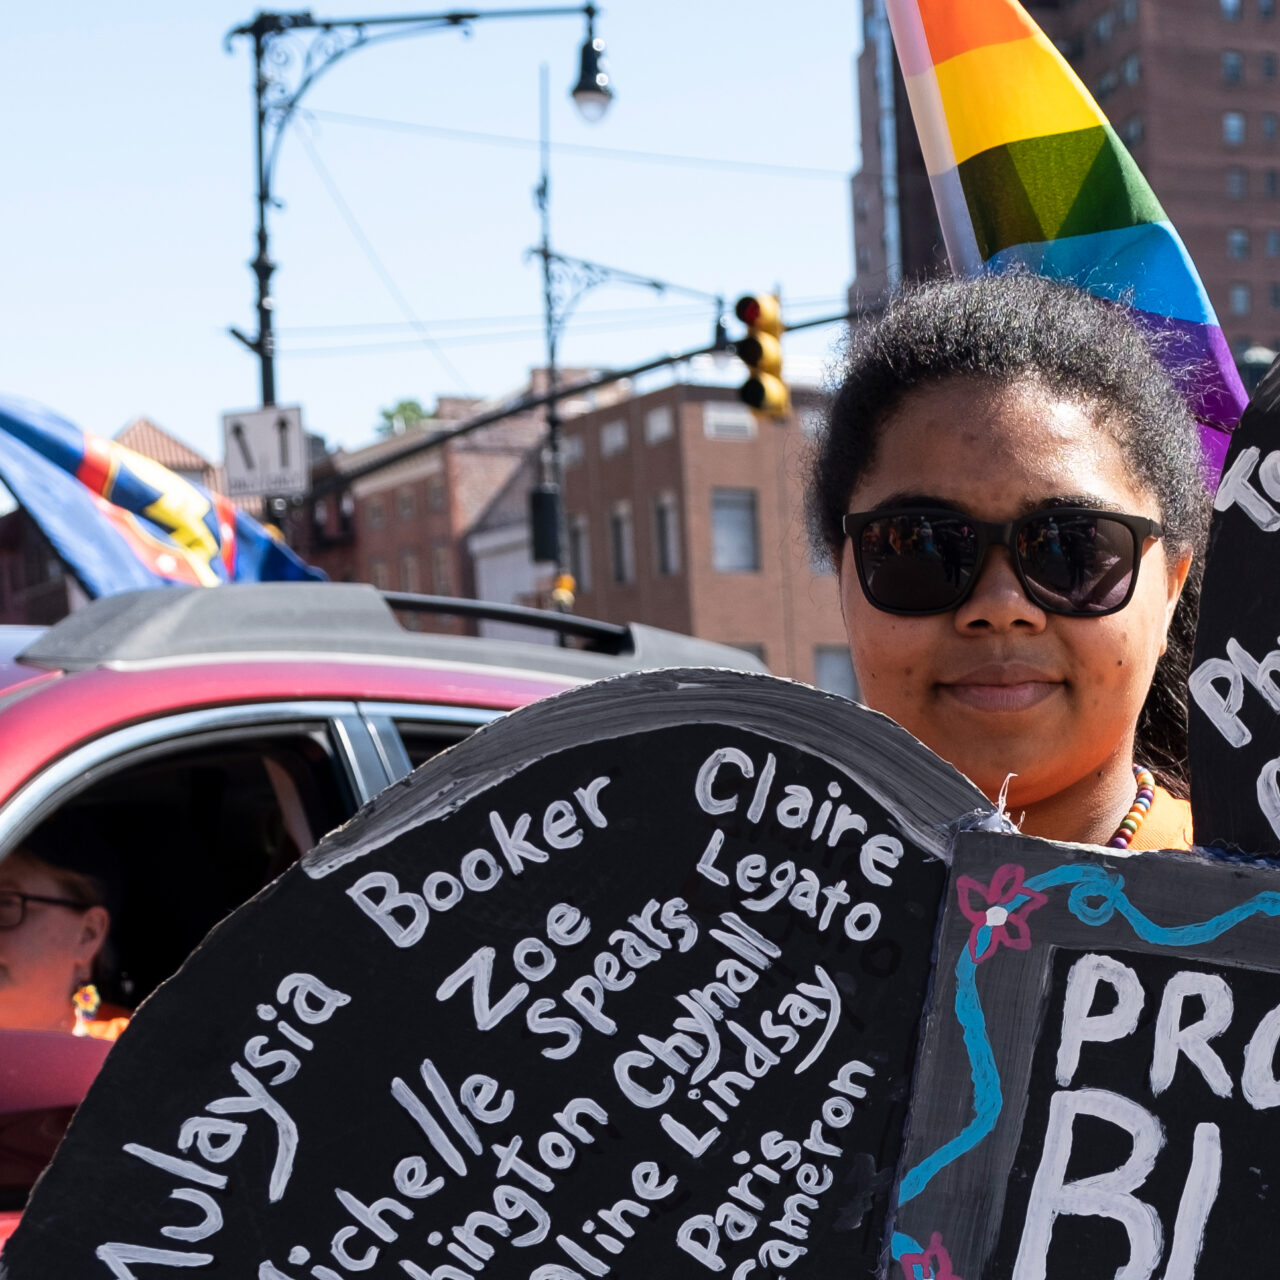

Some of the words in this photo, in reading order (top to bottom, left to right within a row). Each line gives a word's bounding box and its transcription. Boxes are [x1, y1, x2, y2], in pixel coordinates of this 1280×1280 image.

[347, 776, 611, 947] Booker
[694, 747, 905, 887] Claire
[696, 828, 882, 941] Legato
[437, 902, 592, 1031] Zoe
[527, 897, 699, 1060] Spears
[613, 911, 782, 1108] Chynall
[659, 964, 842, 1158] Lindsay
[676, 1129, 802, 1272] Paris
